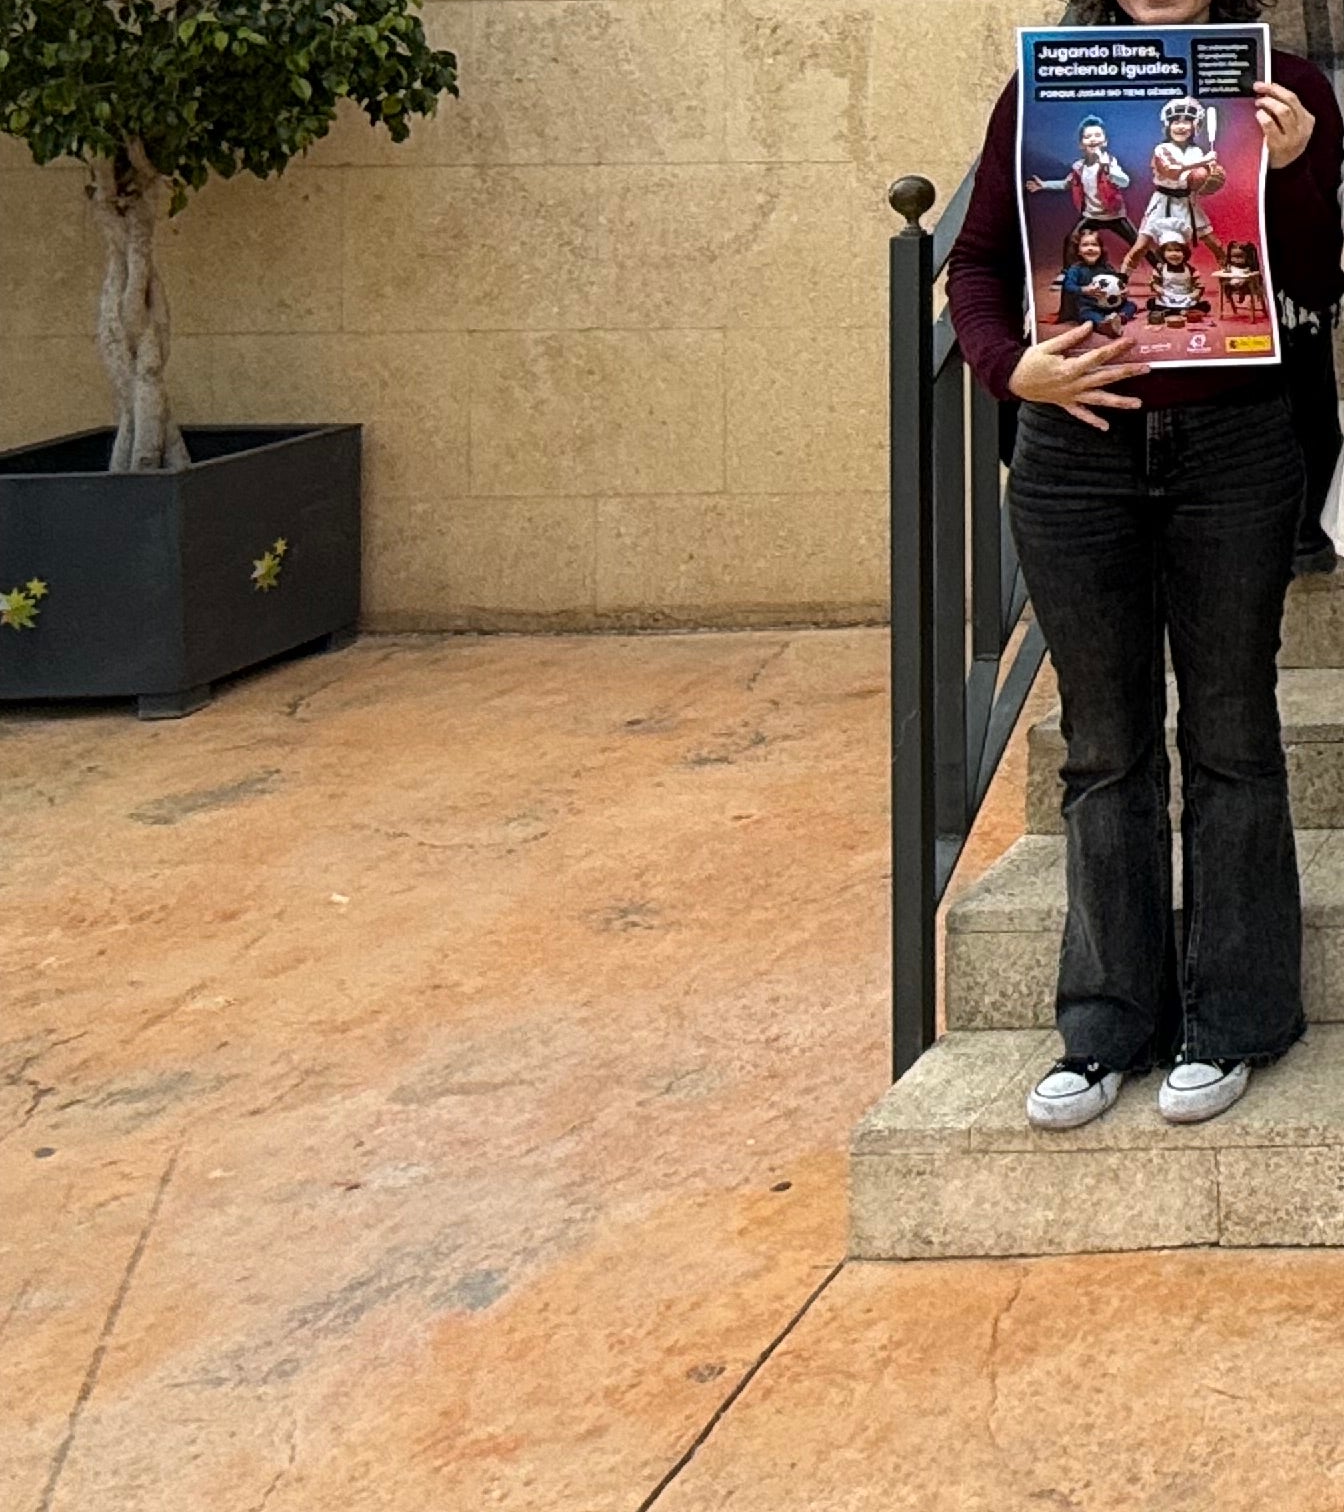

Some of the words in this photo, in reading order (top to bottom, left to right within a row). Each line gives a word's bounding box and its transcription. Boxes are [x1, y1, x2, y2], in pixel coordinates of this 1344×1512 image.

[1038, 44, 1110, 62] Jugando
[1038, 62, 1119, 76] creciendo
[1121, 61, 1184, 79] iguales.
